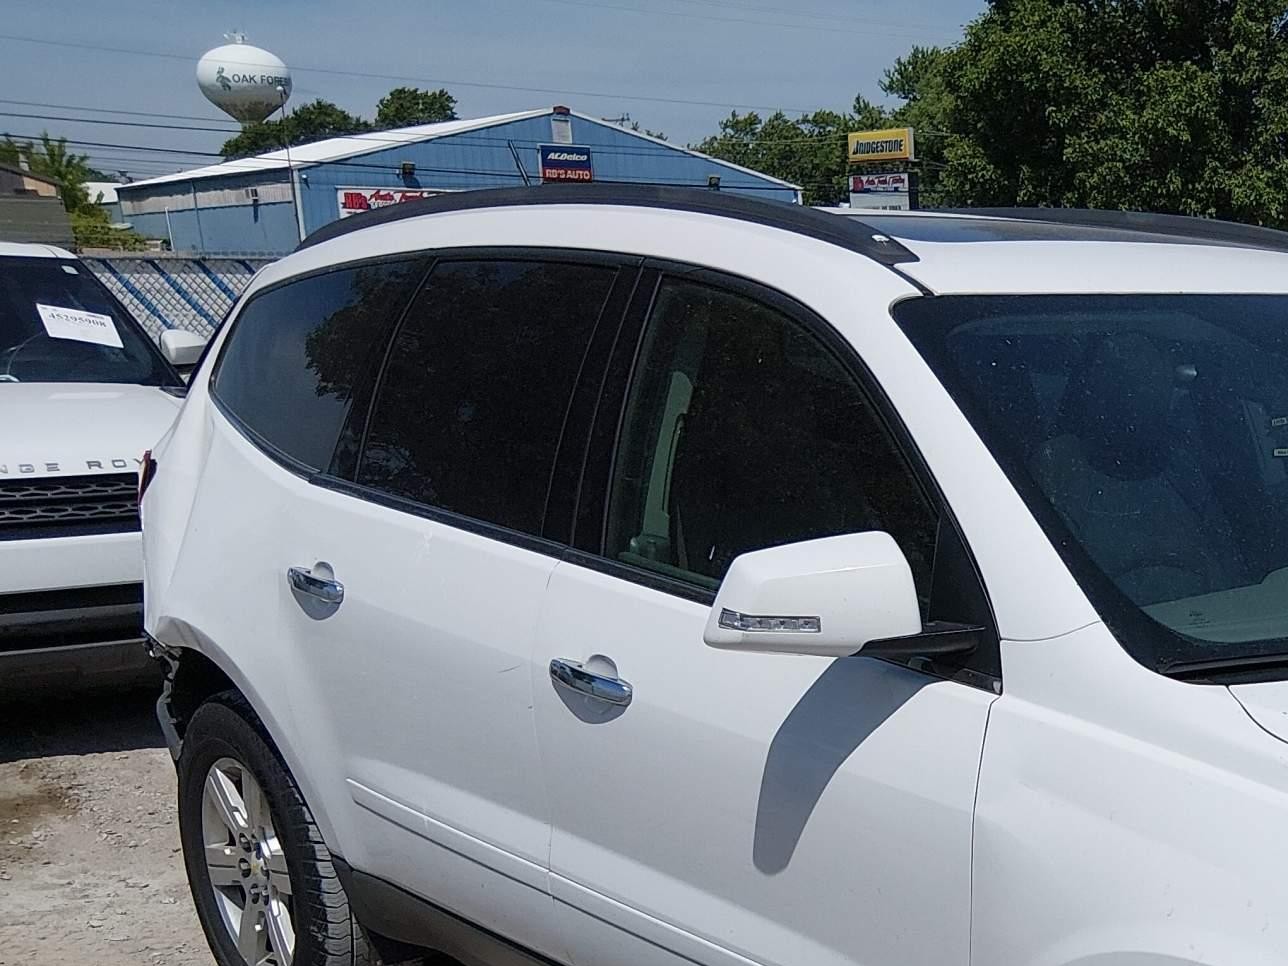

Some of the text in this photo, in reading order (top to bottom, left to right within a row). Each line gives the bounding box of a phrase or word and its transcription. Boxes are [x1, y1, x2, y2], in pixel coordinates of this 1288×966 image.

[232, 74, 257, 84] OAK
[852, 139, 904, 155] BRIDGESTONE
[547, 152, 588, 161] ACDelco
[566, 170, 590, 180] AUTO
